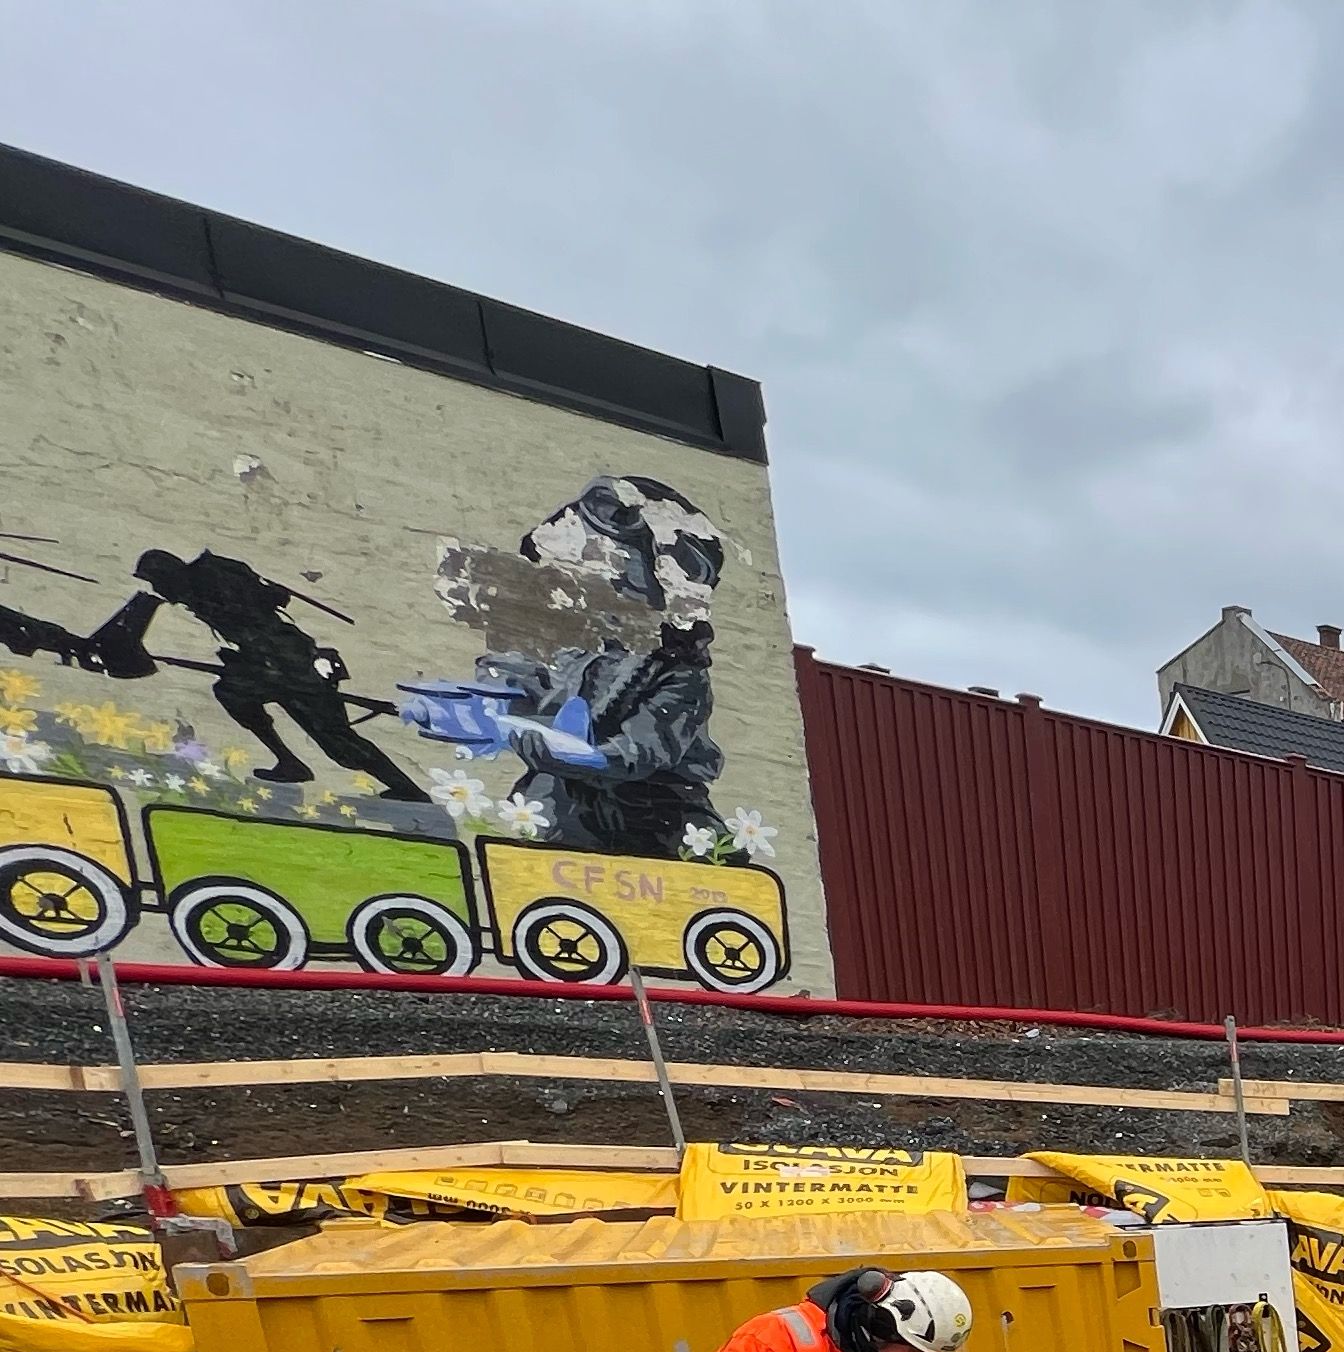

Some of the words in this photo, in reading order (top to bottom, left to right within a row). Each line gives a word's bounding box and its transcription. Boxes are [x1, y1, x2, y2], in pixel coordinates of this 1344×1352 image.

[720, 1182, 918, 1194] VINTERMATTE
[735, 1201, 752, 1210] 50
[779, 1198, 814, 1207] 1200
